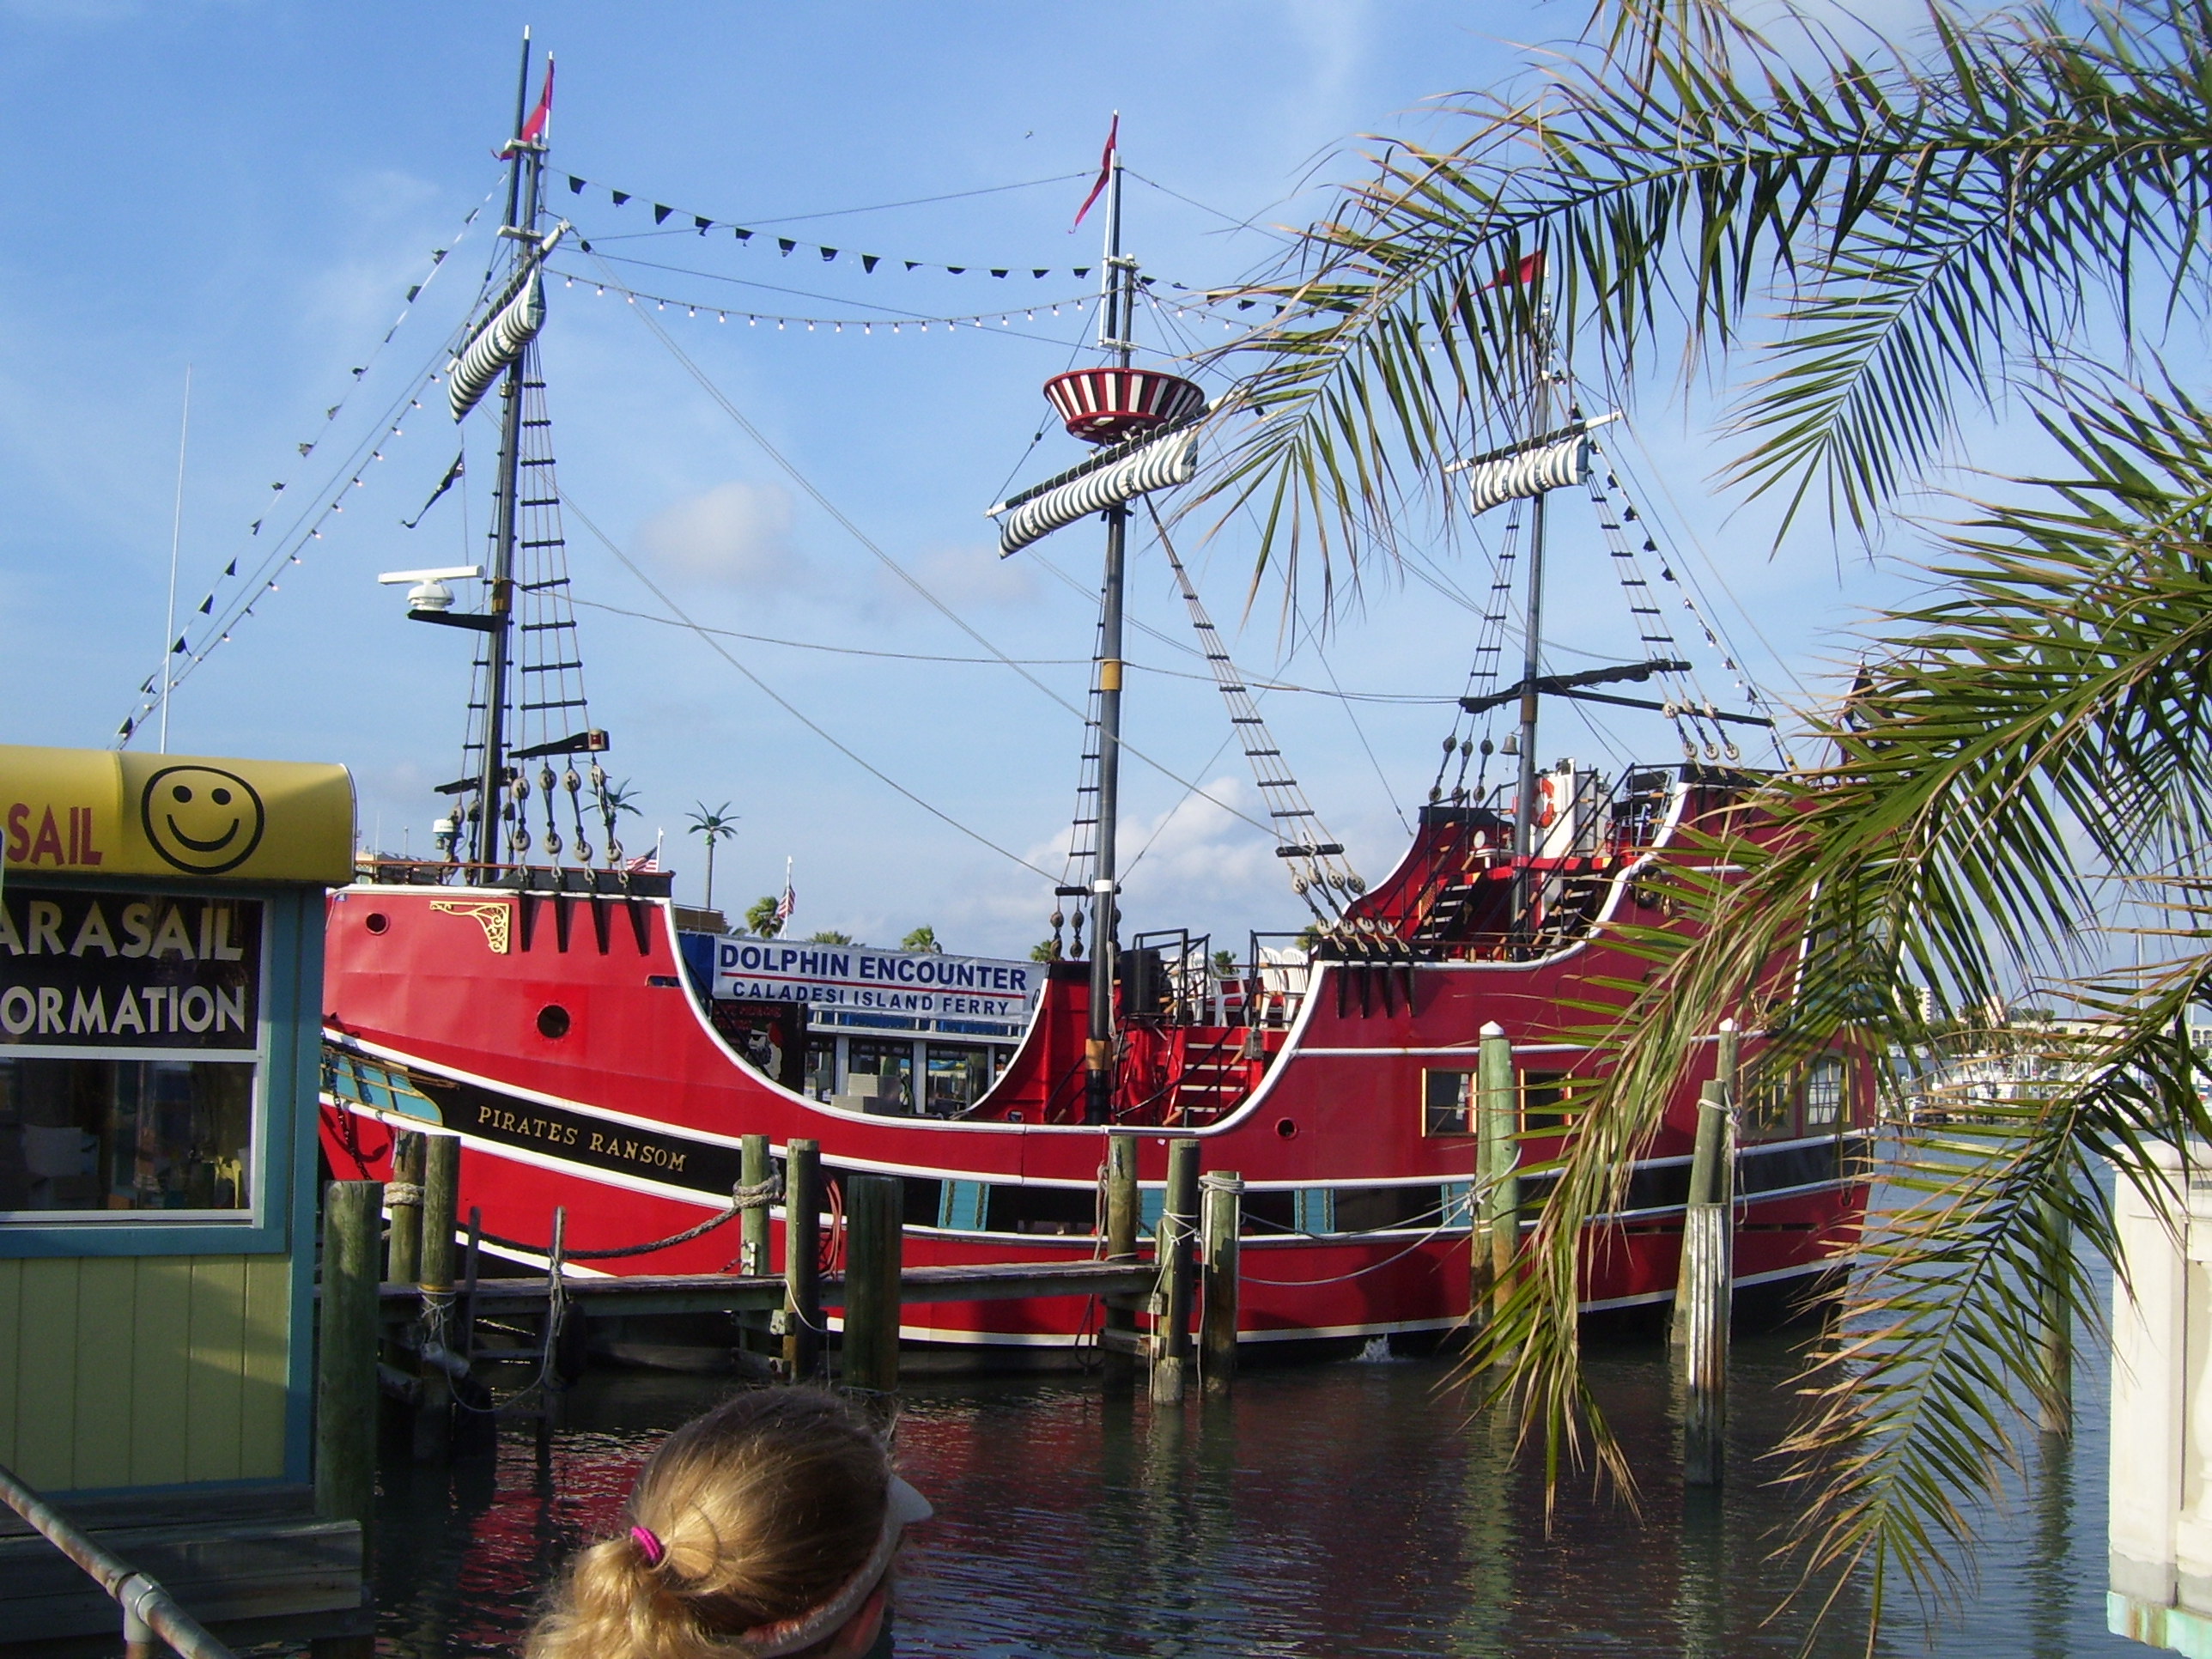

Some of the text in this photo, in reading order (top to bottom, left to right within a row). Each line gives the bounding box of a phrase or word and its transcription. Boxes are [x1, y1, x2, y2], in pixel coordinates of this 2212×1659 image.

[6, 803, 103, 866] SAIL
[720, 944, 1027, 991] DOLPHIN ENCOUNTER
[0, 983, 246, 1036] ORMATION
[732, 981, 1009, 1016] CALADESI ISLAND FERRY
[477, 1105, 687, 1172] PIRATES RANSOM
